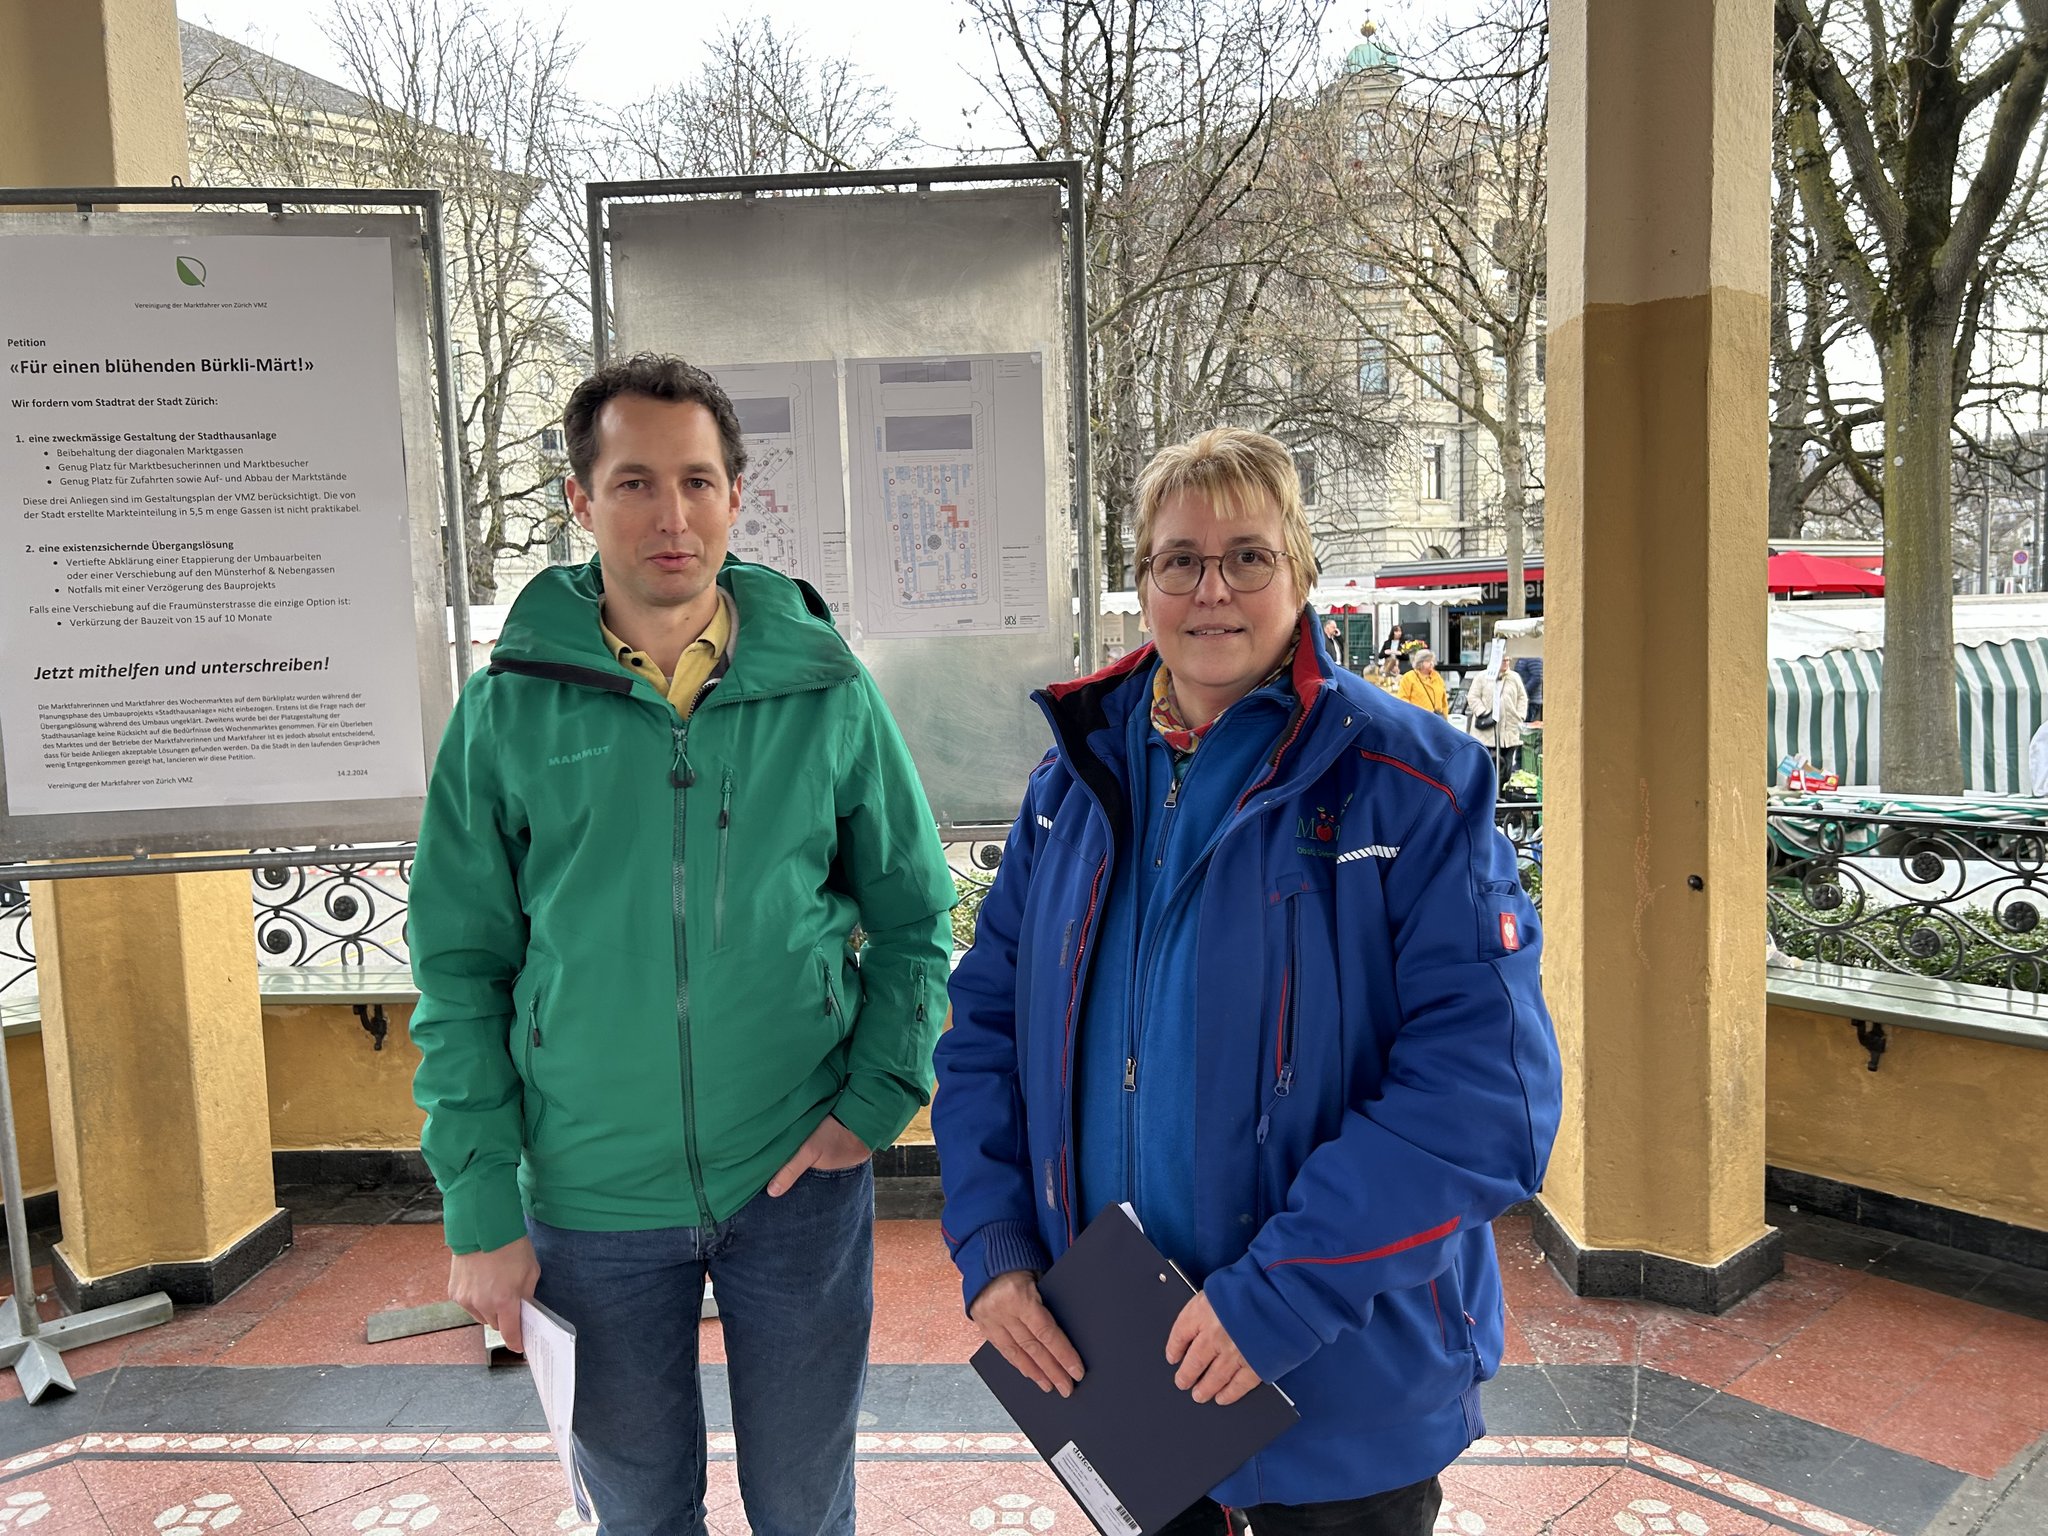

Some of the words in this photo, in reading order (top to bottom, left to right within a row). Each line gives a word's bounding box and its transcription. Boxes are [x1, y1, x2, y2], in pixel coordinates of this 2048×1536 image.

[134, 302, 171, 310] Vereinigung
[7, 337, 46, 347] Petition
[10, 359, 48, 374] «Für
[52, 359, 100, 373] einen
[105, 358, 195, 373] blühenden
[200, 357, 314, 372] Bürkli-Märt!»
[11, 399, 30, 408] Wir
[31, 398, 69, 407] fordern
[95, 397, 136, 406] Stadtrat
[137, 397, 154, 406] der
[156, 397, 183, 406] Stadt
[184, 396, 218, 405] Zürich:
[15, 434, 24, 443] 1.
[28, 434, 50, 443] eine
[51, 433, 121, 443] zweckmässige
[123, 432, 177, 442] Gestaltung
[178, 431, 195, 440] der
[197, 430, 277, 441] Stadthausanlage
[56, 448, 116, 458] Beibehaltung
[117, 447, 133, 456] der
[135, 446, 185, 457] diagonalen
[187, 446, 243, 456] Marktgassen
[57, 463, 88, 472] Genug
[89, 462, 111, 470] Platz
[113, 461, 127, 470] für
[128, 460, 221, 470] Marktbesucherinnen
[223, 460, 241, 468] und
[243, 459, 308, 468] Marktbesucher
[59, 477, 90, 487] Genug
[91, 476, 113, 485] Platz
[114, 475, 128, 484] für
[129, 475, 174, 484] Zufahrten
[203, 474, 222, 482] Auf-
[224, 474, 242, 482] und
[244, 473, 273, 482] Abbau
[274, 473, 289, 481] der
[291, 472, 347, 481] Marktstände
[22, 497, 48, 505] Diese
[49, 496, 68, 505] drei
[69, 495, 108, 505] Anliegen
[110, 495, 129, 503] sind
[144, 493, 215, 504] Gestaltungsplan
[217, 493, 233, 501] der
[234, 492, 256, 501] VMZ
[323, 491, 338, 499] Die
[23, 511, 39, 519] der
[40, 510, 65, 518] Stadt
[67, 509, 104, 518] erstellte
[106, 508, 177, 517] Markteinteilung
[189, 507, 203, 516] 5,5
[216, 508, 238, 516] enge
[240, 506, 272, 514] Gassen
[274, 506, 285, 514] ist
[286, 505, 309, 513] nicht
[25, 544, 35, 553] 2.
[38, 544, 60, 552] eine
[62, 541, 149, 552] existenzsichernde
[151, 540, 234, 551] Übergangslösung
[65, 557, 106, 566] Vertiefte
[108, 557, 154, 566] Abklärung
[155, 556, 179, 564] einer
[181, 555, 235, 565] Etappierung
[236, 554, 251, 562] der
[253, 553, 322, 562] Umbauarbeiten
[66, 571, 88, 580] oder
[90, 571, 114, 579] einer
[115, 569, 177, 579] Verschiebung
[178, 568, 193, 577] auf
[195, 568, 212, 577] den
[214, 566, 266, 576] Münsterhof
[268, 566, 276, 575] &
[277, 566, 335, 575] Nebengassen
[67, 584, 103, 593] Notfalls
[121, 584, 145, 592] einer
[146, 583, 204, 593] Verzögerung
[205, 582, 222, 590] des
[223, 580, 276, 591] Bauprojekts
[29, 605, 49, 614] Falls
[51, 605, 71, 613] eine
[72, 603, 134, 613] Verschiebung
[135, 602, 151, 611] auf
[152, 602, 167, 610] die
[168, 601, 256, 610] Fraumünsterstrasse
[258, 599, 272, 607] die
[273, 599, 304, 608] einzige
[306, 598, 336, 607] Option
[69, 618, 121, 627] Verkürzung
[123, 616, 138, 625] der
[140, 616, 173, 624] Bauzeit
[194, 614, 206, 623] 15
[207, 614, 222, 623] auf
[224, 614, 235, 622] 10
[237, 613, 272, 622] Monate
[33, 666, 74, 680] Jetzt
[78, 662, 159, 680] mithelfen
[164, 660, 196, 675] und
[201, 656, 329, 674] unterschreiben!
[50, 701, 109, 710] Marktfahrerinnen
[124, 699, 165, 707] Marktfahrer
[179, 697, 233, 705] Wochenmarktes
[262, 694, 295, 703] Bürkliplatz
[321, 692, 350, 700] während
[38, 712, 88, 722] Planungsphase
[102, 710, 153, 719] Umbauprojekts
[320, 703, 337, 711] Frage
[548, 745, 610, 766] MAMMUT
[47, 781, 87, 791] Vereinigung
